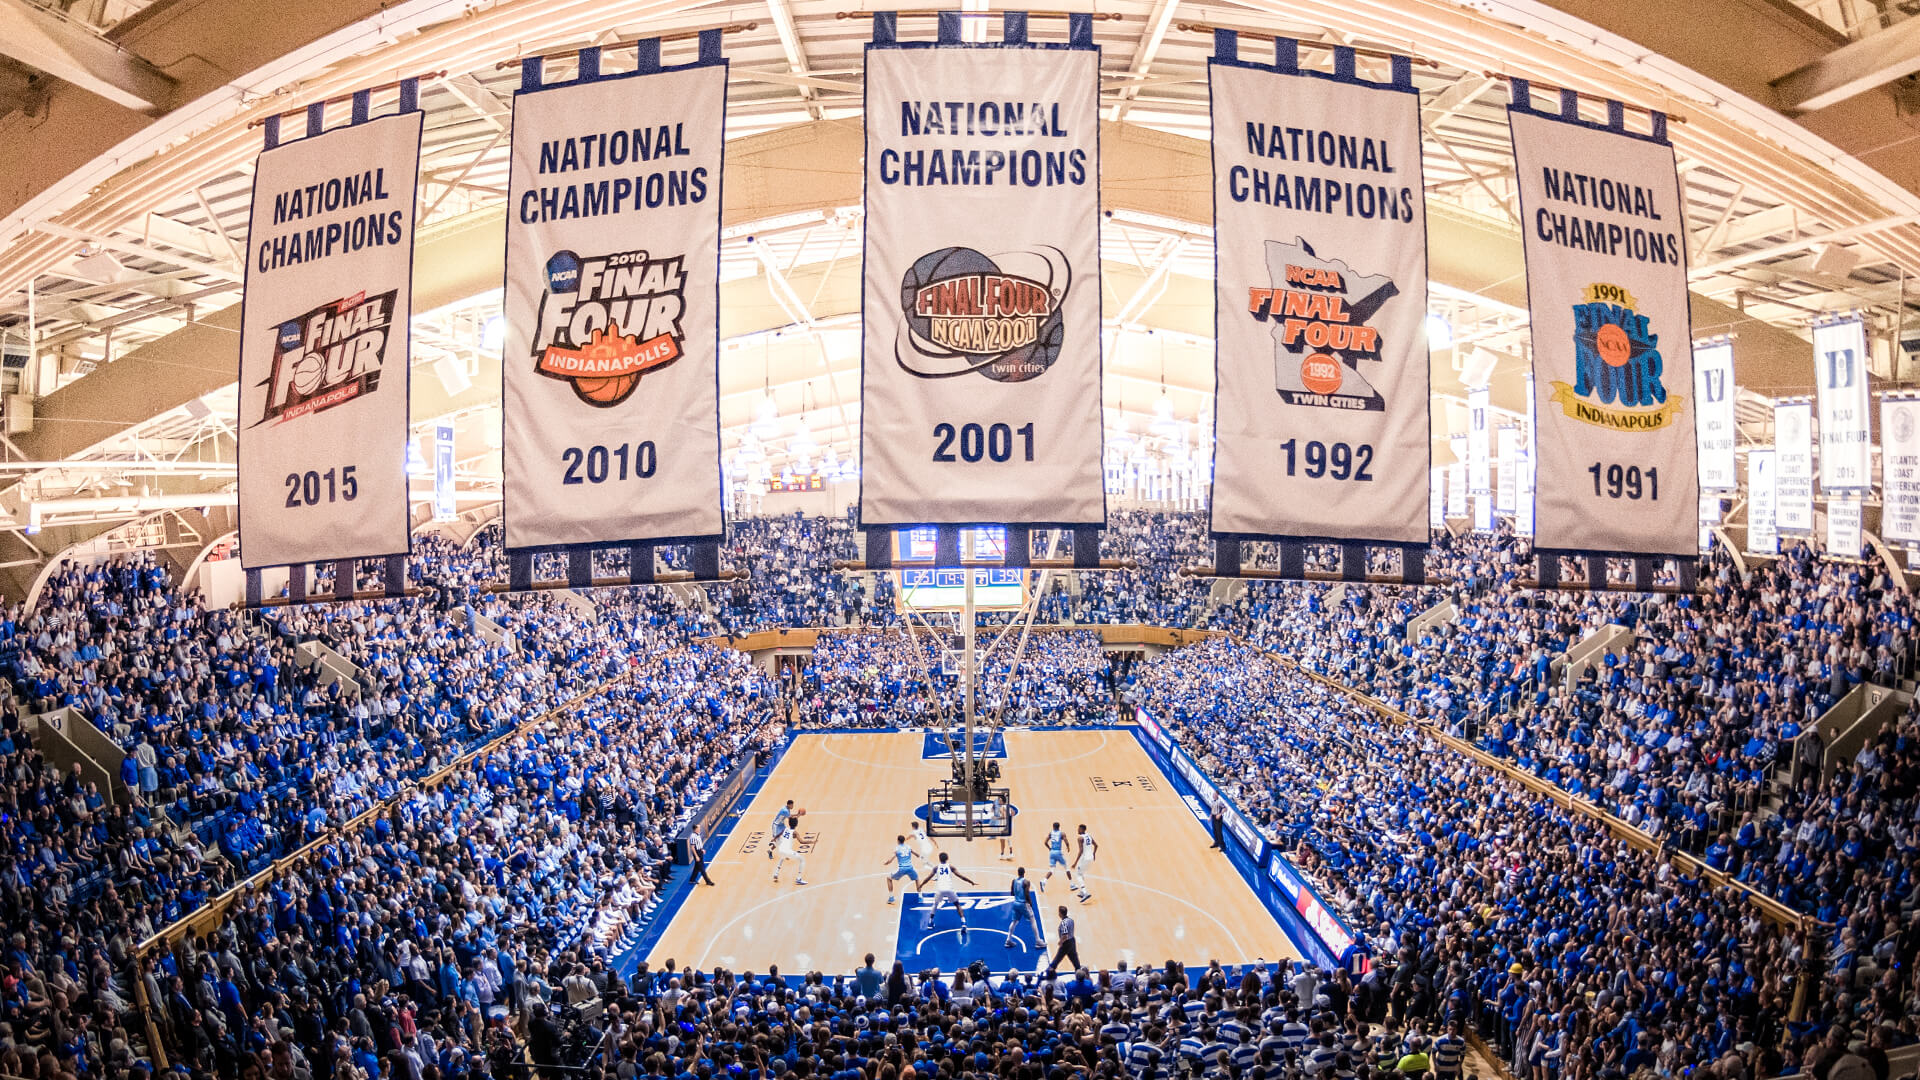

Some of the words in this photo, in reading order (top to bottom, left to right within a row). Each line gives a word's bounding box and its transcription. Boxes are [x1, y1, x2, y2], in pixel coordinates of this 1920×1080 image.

[901, 101, 1068, 138] NATIONAL
[539, 123, 690, 174] NATIONAL
[880, 148, 1087, 187] CHAMPIONS
[1247, 122, 1397, 174] NATIONAL
[273, 167, 388, 225] NATIONAL
[520, 167, 707, 225] CHAMPIONS
[1230, 166, 1413, 224] CHAMPIONS
[1543, 167, 1661, 220] NATIONAL
[258, 210, 402, 273] CHAMPIONS
[1537, 208, 1678, 266] CHAMPIONS
[551, 270, 577, 282] NCAA
[609, 252, 647, 266] 2010
[1285, 264, 1341, 289] NCAA
[578, 261, 682, 302] FINAL
[918, 277, 984, 316] FINAL
[986, 276, 1048, 316] FOUR
[1593, 285, 1627, 304] 1991
[536, 292, 680, 350] FOUR
[1249, 287, 1350, 322] FINAL
[304, 299, 385, 354] FINAL
[933, 318, 985, 351] NCAA
[985, 318, 1036, 351] 2001
[1283, 319, 1377, 352] FOUR
[1572, 302, 1657, 350] FINAL
[272, 329, 385, 407] FOUR
[549, 342, 670, 372] INDIANAPOLIS
[992, 363, 1016, 373] twin
[1018, 362, 1045, 373] cities
[1309, 362, 1335, 379] 1992
[1574, 346, 1666, 407] FOUR
[285, 385, 357, 419] INDIANAPOLIS
[1292, 393, 1328, 406] TWIN
[1329, 396, 1366, 410] CITIES
[1576, 403, 1663, 429] INDIANAPOLIS
[933, 423, 1033, 462] 2001
[1281, 439, 1373, 481] 1992
[563, 441, 656, 484] 2010
[1589, 463, 1657, 500] 1991
[286, 466, 357, 507] 2015
[939, 867, 949, 876] 34
